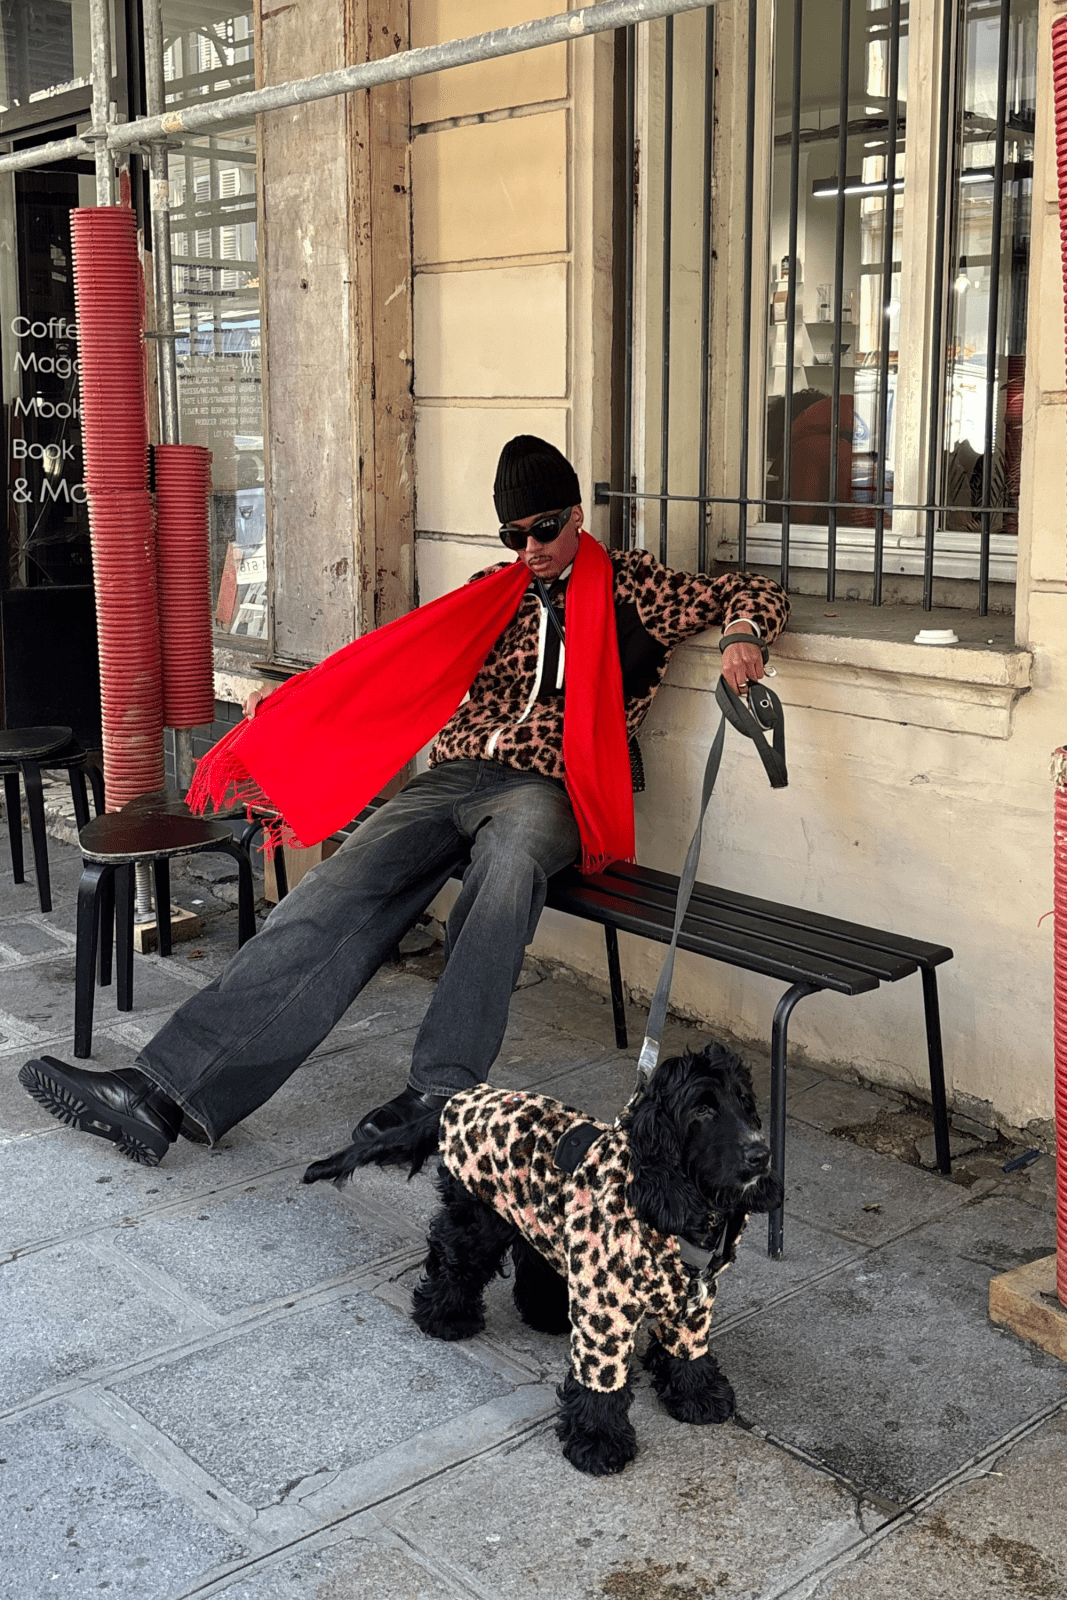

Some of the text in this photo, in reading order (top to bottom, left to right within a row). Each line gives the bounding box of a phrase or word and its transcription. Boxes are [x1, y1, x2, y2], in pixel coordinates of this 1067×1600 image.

[14, 397, 81, 418] Mook
[13, 439, 75, 460] Book
[13, 478, 33, 503] &
